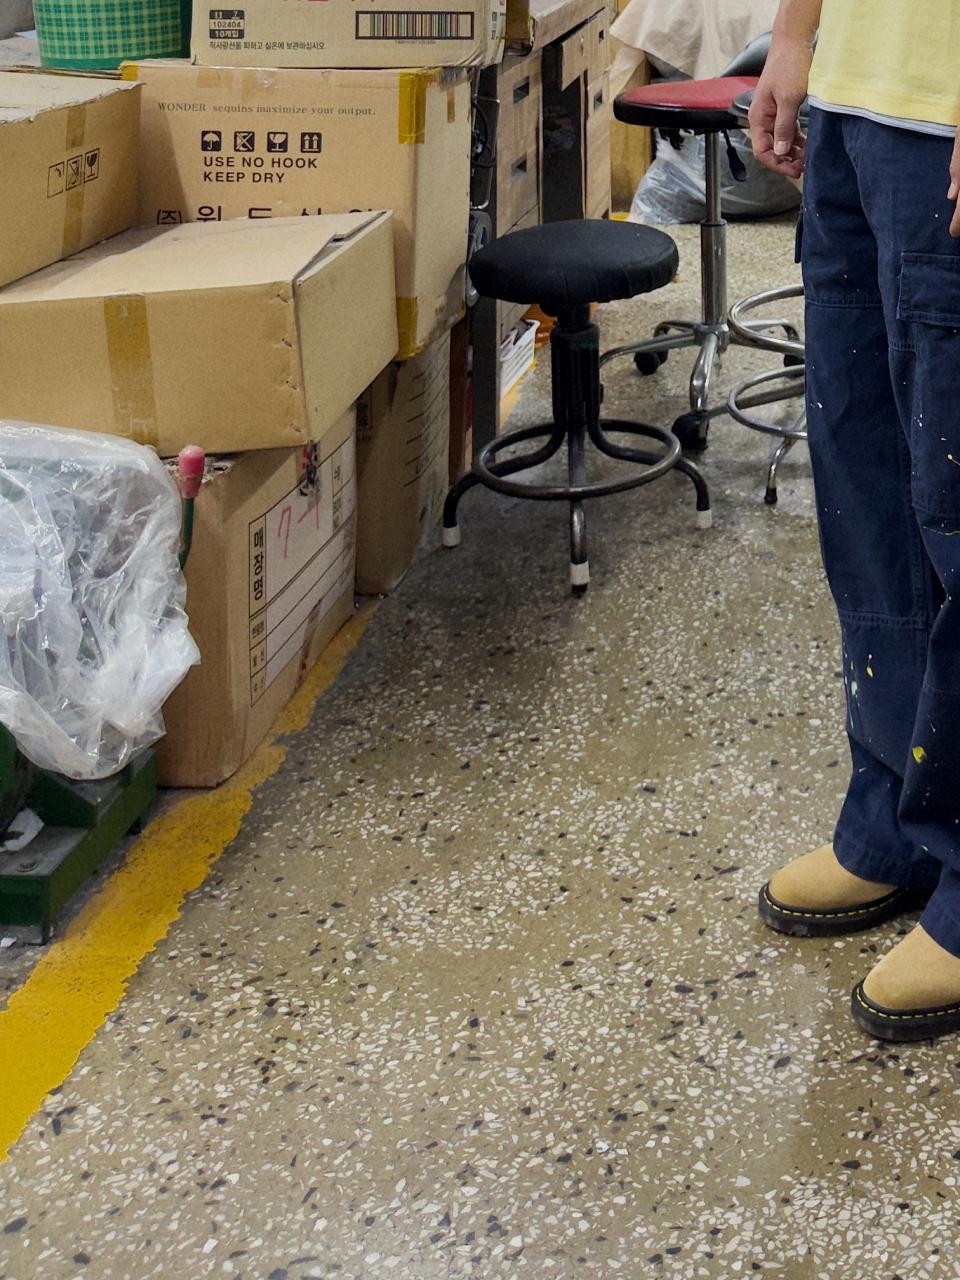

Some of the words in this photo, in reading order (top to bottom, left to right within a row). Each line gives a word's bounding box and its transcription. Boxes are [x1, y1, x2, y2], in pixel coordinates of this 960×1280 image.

[157, 102, 206, 112] WONDER
[204, 156, 235, 168] USE
[242, 157, 264, 168] NO
[271, 157, 318, 169] HOOK
[204, 171, 246, 183] KEEP
[252, 172, 285, 184] DRY
